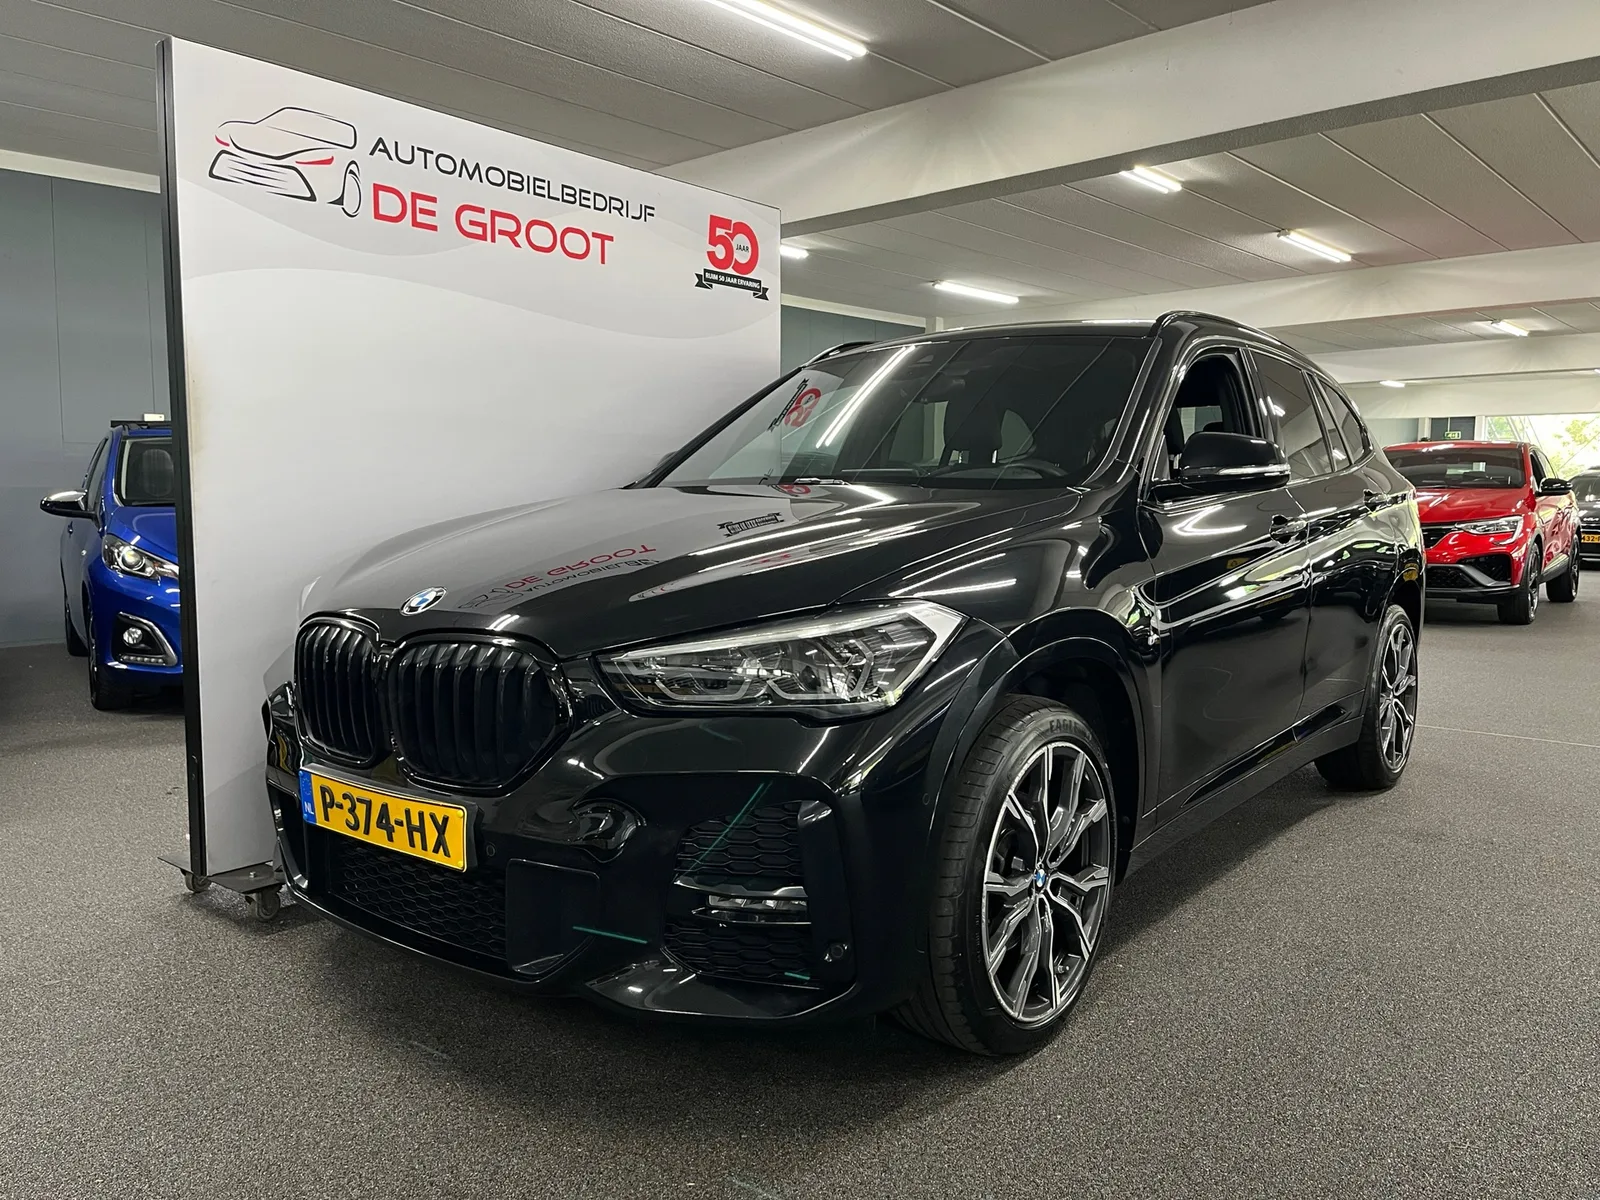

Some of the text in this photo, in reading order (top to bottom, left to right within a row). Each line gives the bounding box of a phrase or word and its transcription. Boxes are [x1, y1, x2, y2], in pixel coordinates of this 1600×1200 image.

[369, 136, 656, 222] AUTOMOBIELBEDRIJF
[372, 182, 614, 265] DE GROOT
[706, 214, 759, 275] 50
[735, 243, 749, 253] JAAR
[705, 272, 719, 281] RUIM
[725, 276, 737, 285] JAAR
[737, 278, 760, 289] ERVARING
[304, 801, 315, 815] NL
[319, 784, 451, 858] P-374-HX
